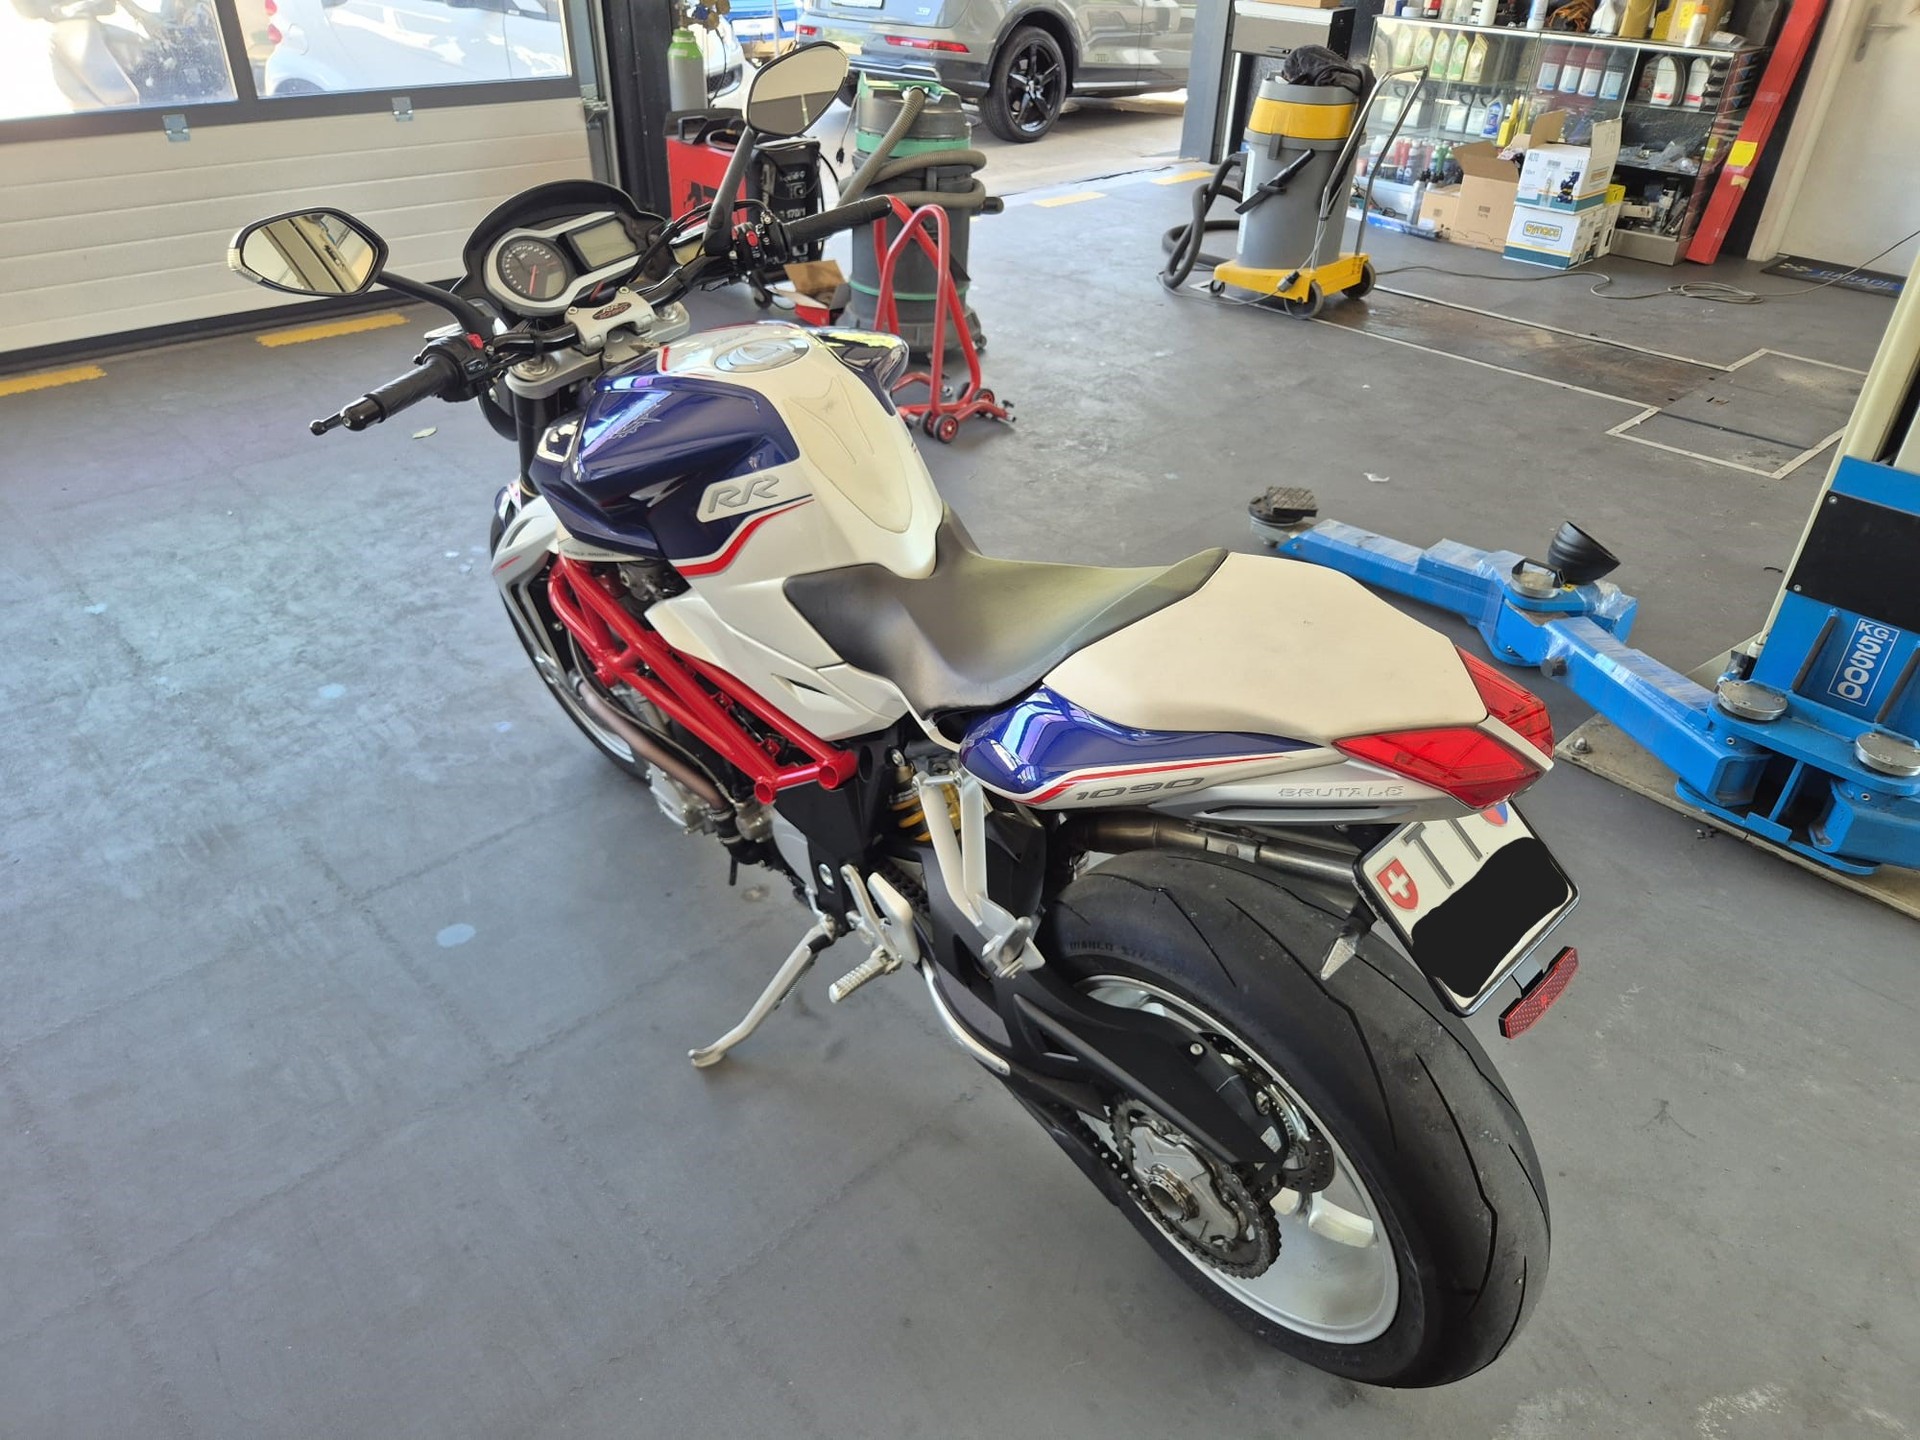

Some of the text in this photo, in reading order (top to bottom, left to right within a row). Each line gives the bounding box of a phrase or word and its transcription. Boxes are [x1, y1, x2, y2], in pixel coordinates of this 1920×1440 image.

[707, 474, 780, 514] RR
[1837, 634, 1884, 699] 5500
[1075, 777, 1205, 802] 1090
[1278, 785, 1406, 798] BRUTALE
